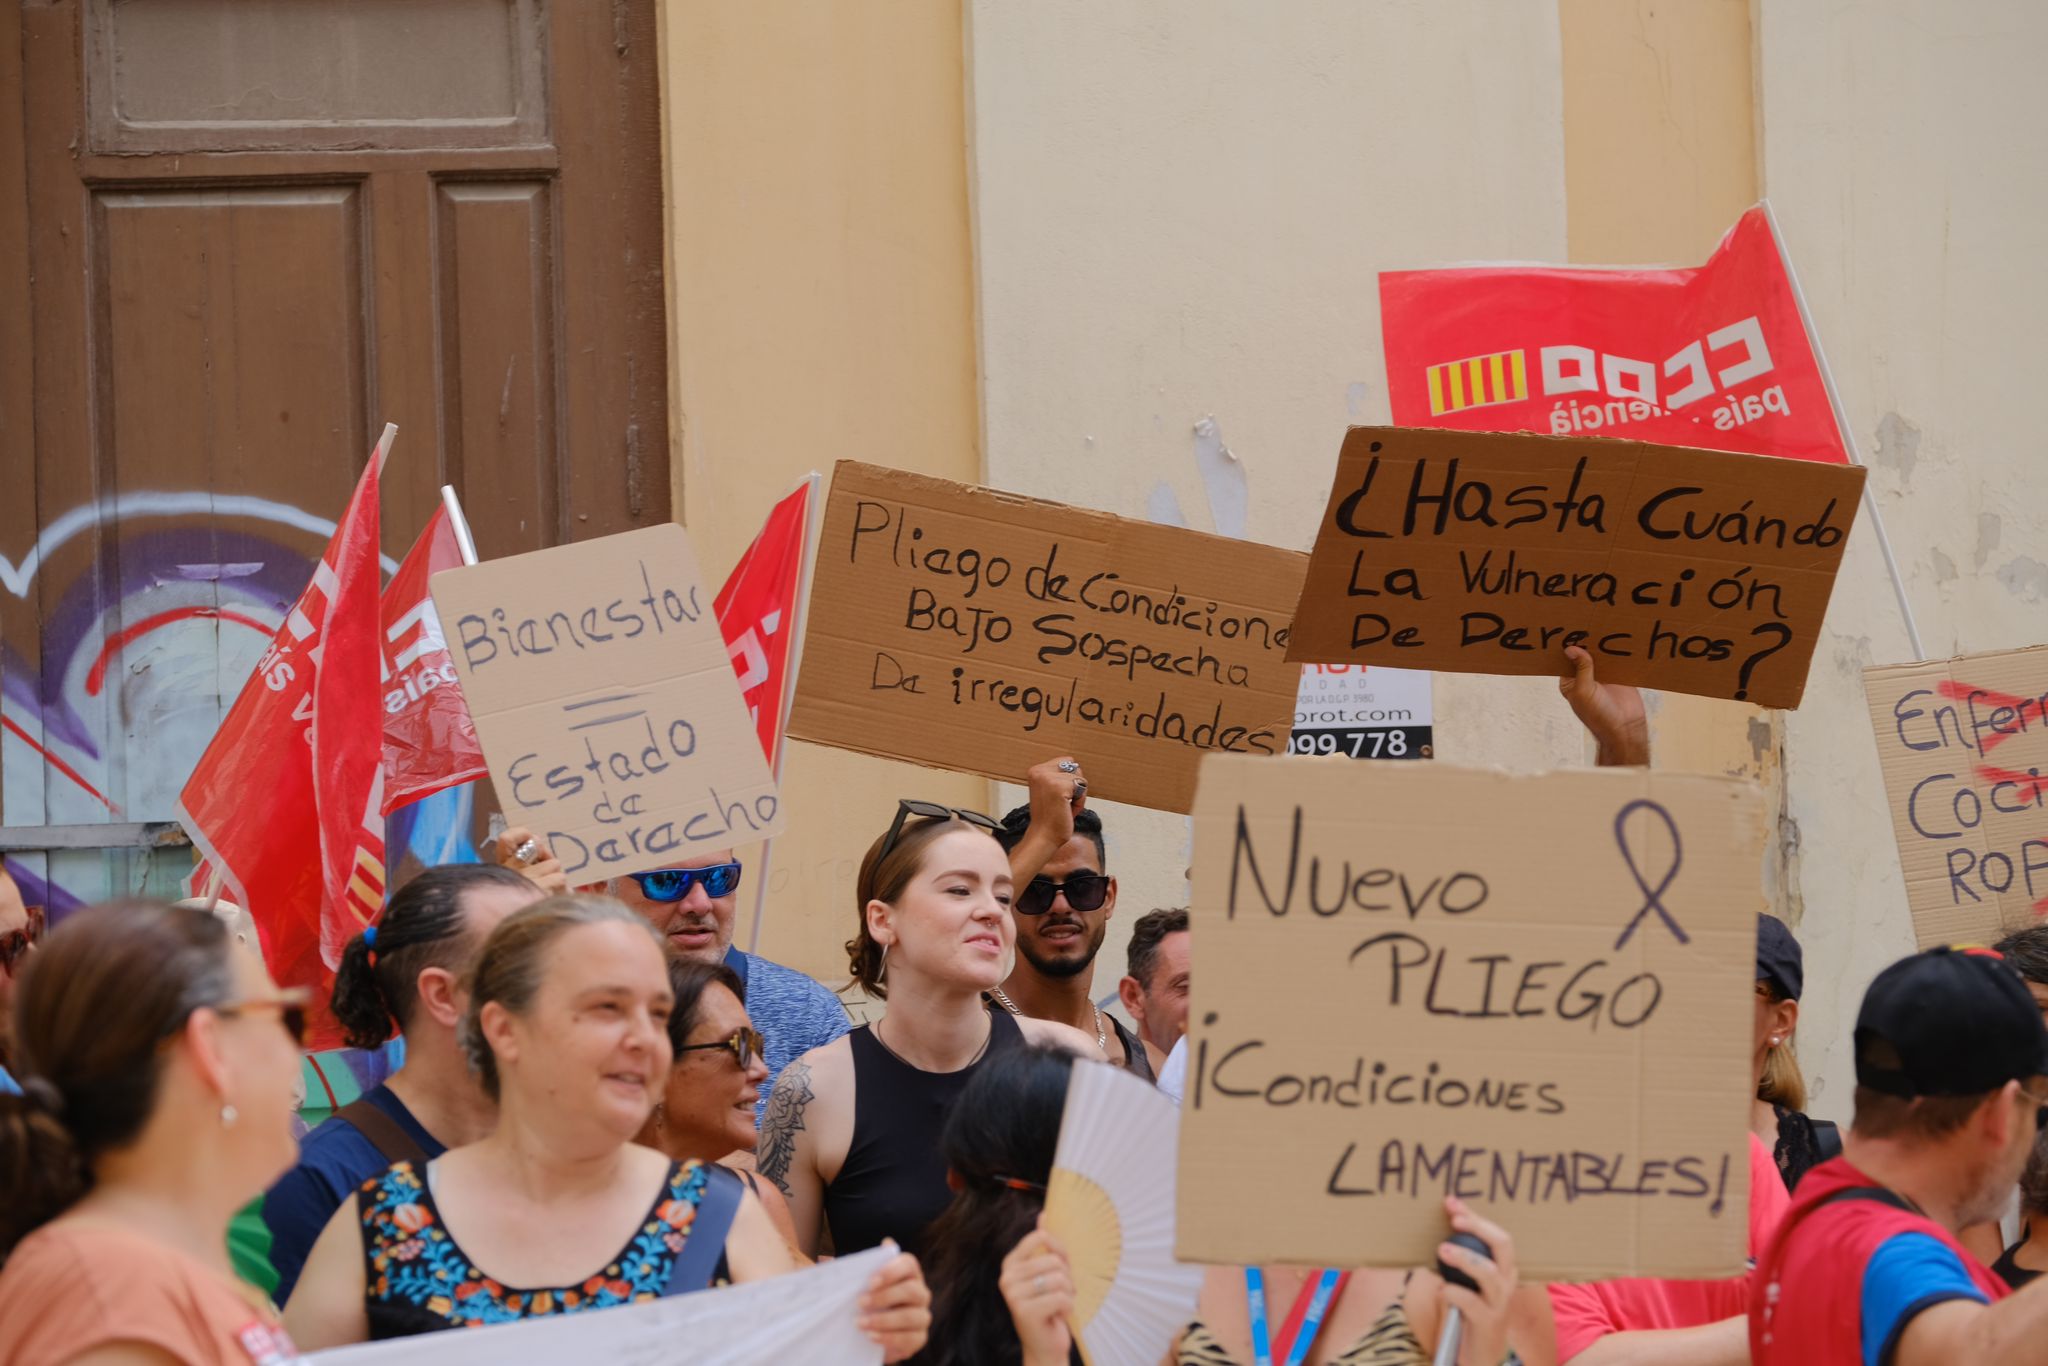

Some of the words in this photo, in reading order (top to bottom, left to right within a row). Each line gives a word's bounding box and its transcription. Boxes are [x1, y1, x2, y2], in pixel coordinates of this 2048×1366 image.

[1335, 441, 1606, 540] ¿Hasta
[1637, 486, 1843, 549] Cuándo
[850, 501, 1011, 598] Pliego
[1026, 543, 1075, 603] de
[1347, 550, 1434, 601] La
[1459, 550, 1788, 619] Vulneración
[457, 560, 700, 672] Bienestar
[1032, 613, 1249, 688] Sospecha
[1350, 612, 1424, 650] De
[870, 652, 926, 694] De
[951, 667, 1275, 756] irregularidades
[1346, 729, 1408, 758] 778
[508, 716, 697, 808] Estado
[547, 787, 777, 874] Derecho
[593, 791, 646, 824] de
[1348, 932, 1662, 1033] PLIEGO
[1326, 1139, 1731, 1217] LAMENTABLES!
